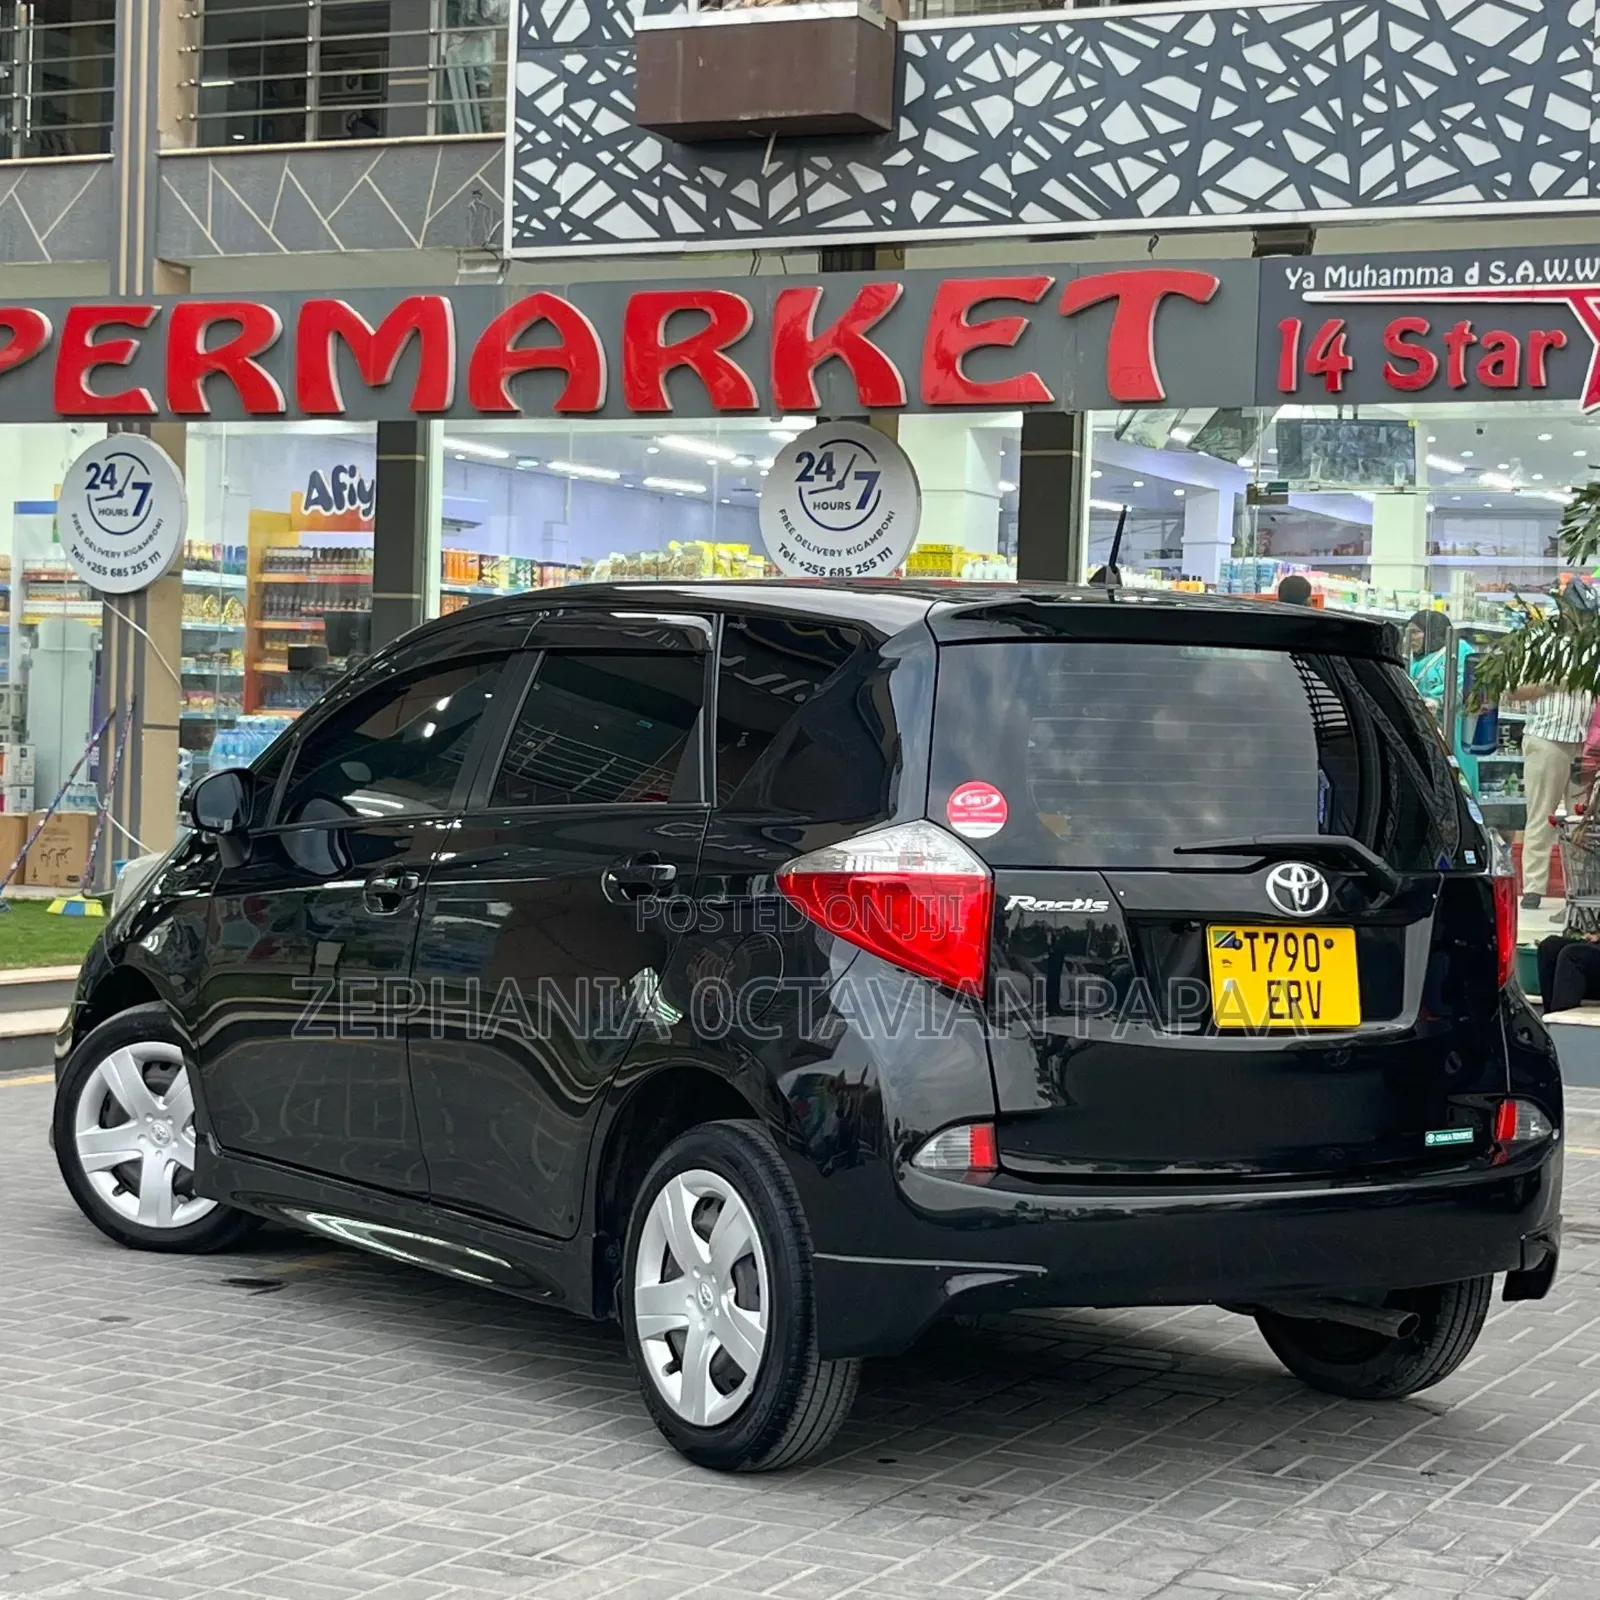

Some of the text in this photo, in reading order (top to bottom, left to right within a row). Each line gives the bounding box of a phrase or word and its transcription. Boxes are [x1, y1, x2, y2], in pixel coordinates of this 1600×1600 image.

[1285, 267, 1315, 290] Ya
[1277, 316, 1568, 392] 14 Star
[85, 462, 118, 491] 24
[795, 451, 836, 482] 24
[302, 464, 375, 519] Afiy
[812, 501, 851, 511] HOURS
[98, 507, 129, 517] HOURS
[71, 513, 85, 537] FREE
[84, 537, 121, 559] DELIVERY
[778, 508, 896, 557] FREE DELIVERY KIGAMBONI
[86, 560, 108, 576] +255
[110, 565, 129, 577] 685
[131, 561, 149, 575] 255
[778, 543, 797, 565] Tel:
[798, 560, 827, 577] +255
[855, 559, 877, 575] 255
[1004, 895, 1109, 913] Ractis
[1243, 931, 1321, 973] T790
[1266, 979, 1322, 1020] ERV
